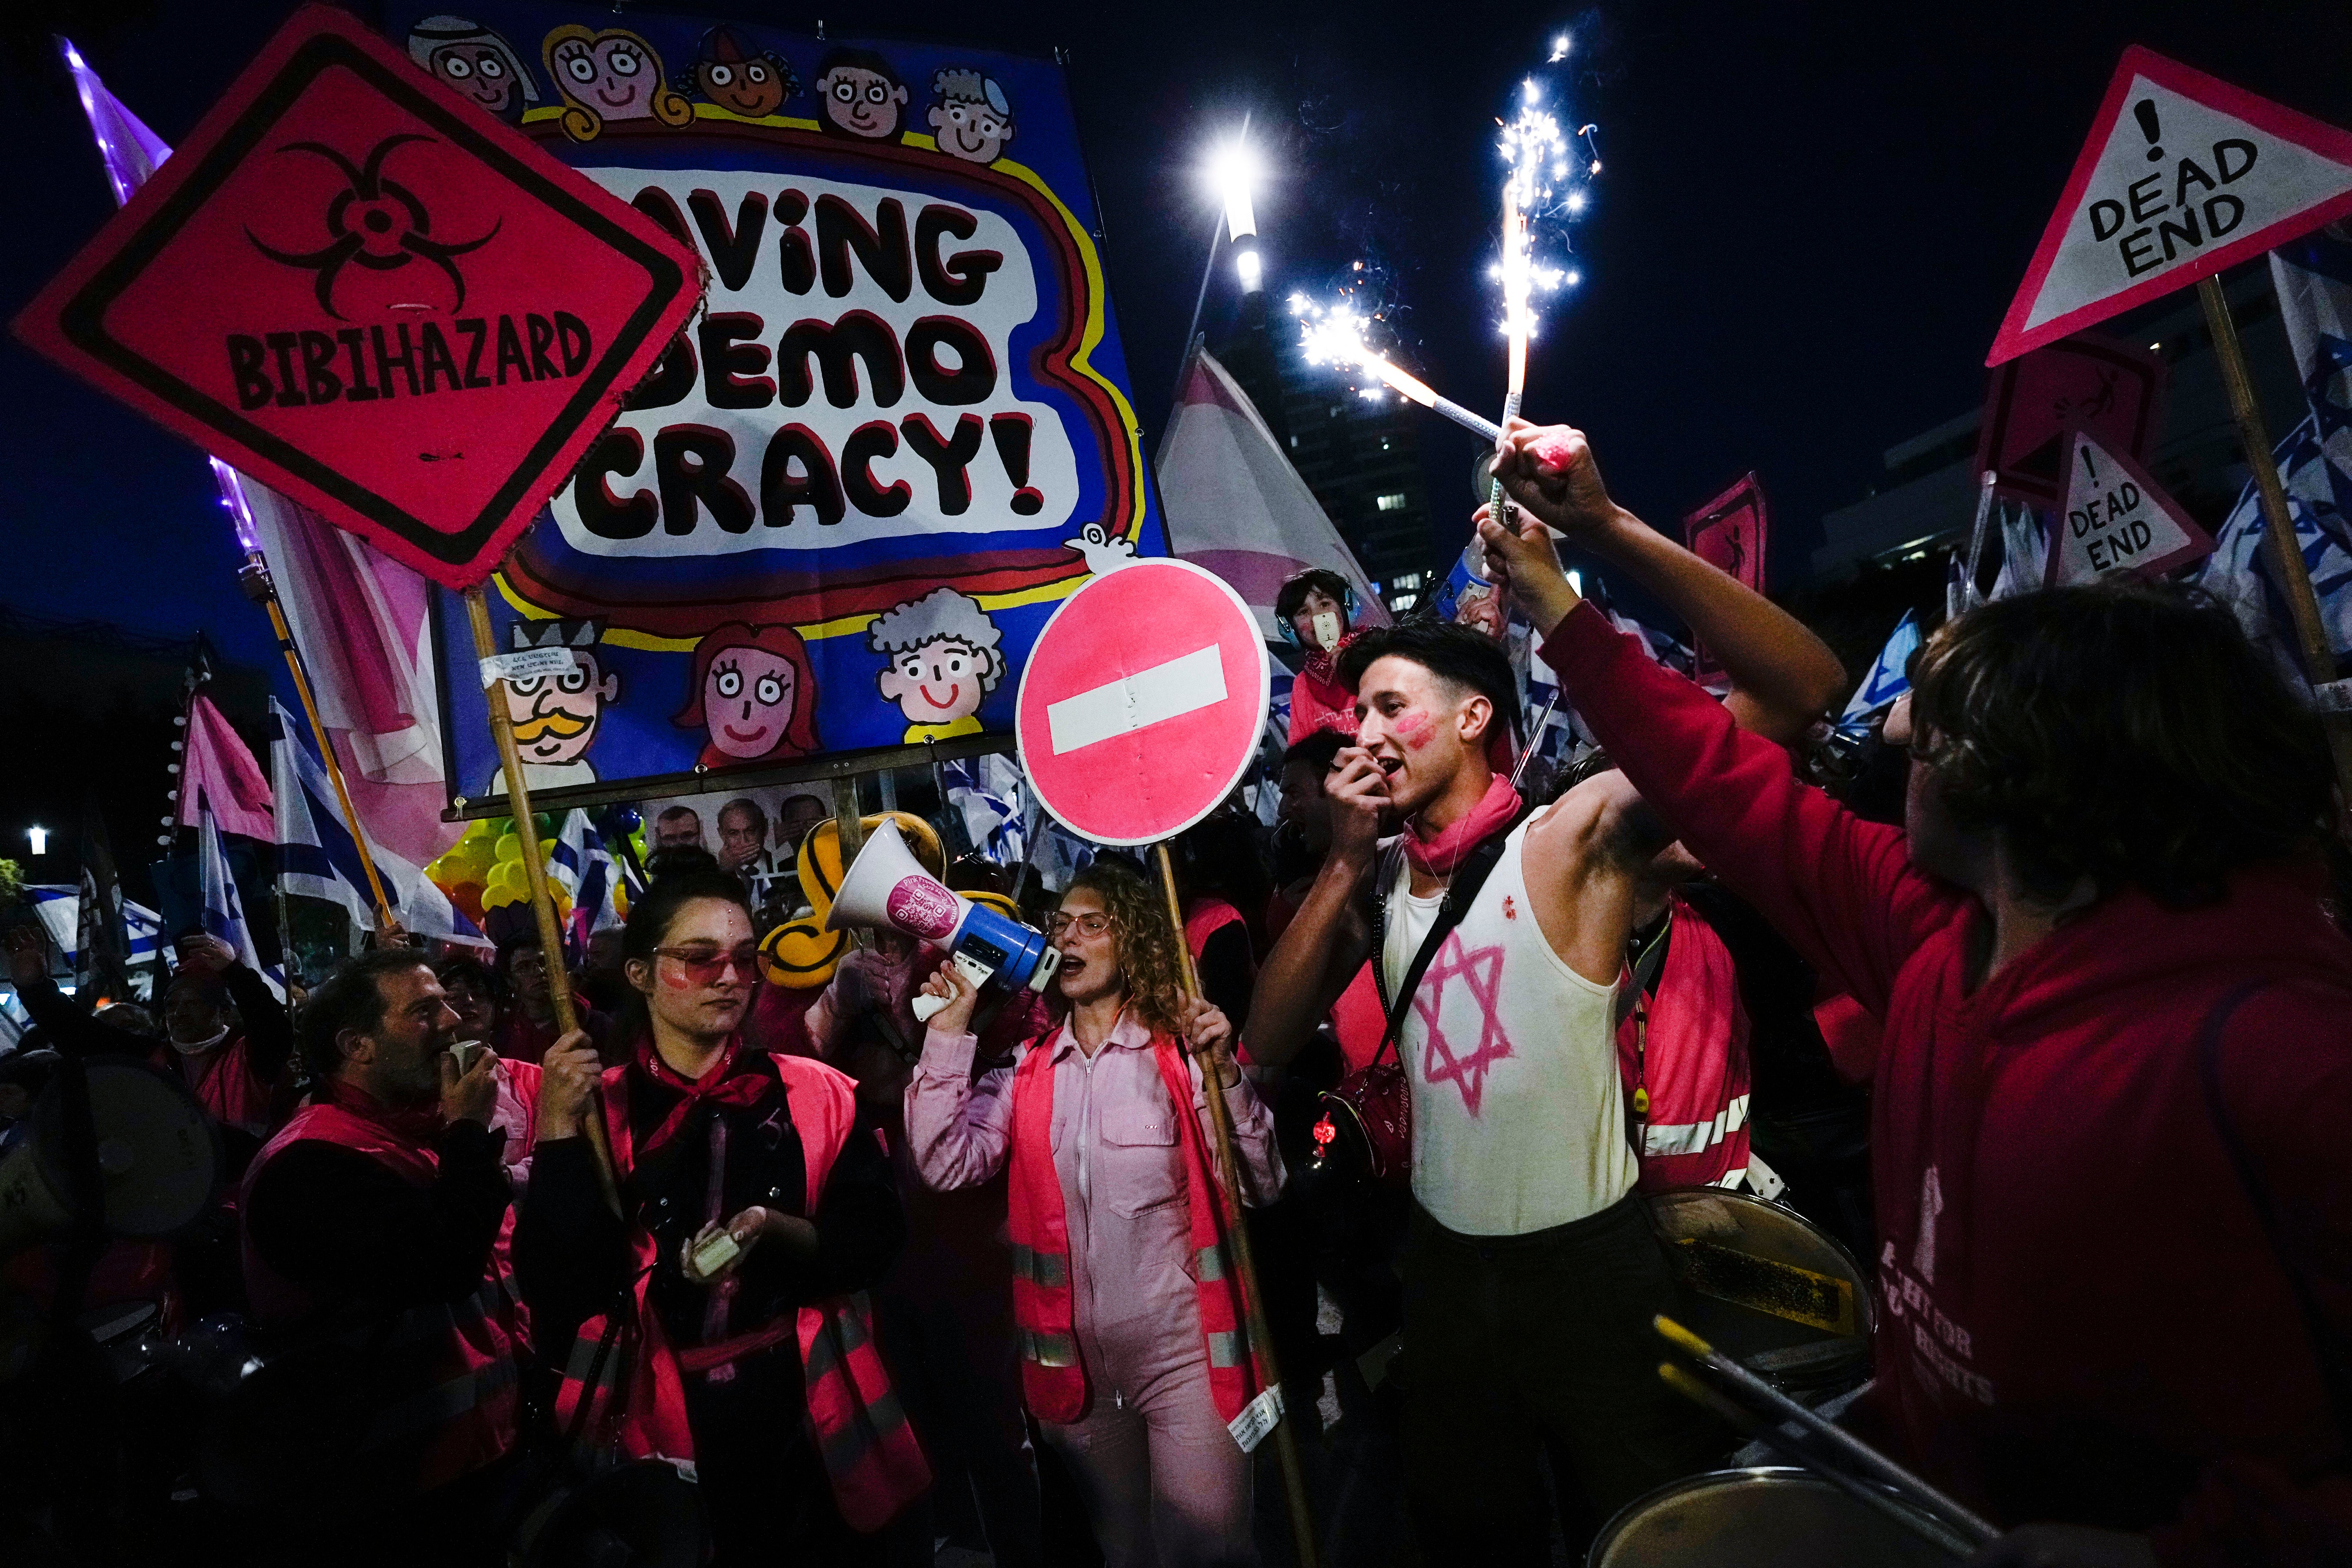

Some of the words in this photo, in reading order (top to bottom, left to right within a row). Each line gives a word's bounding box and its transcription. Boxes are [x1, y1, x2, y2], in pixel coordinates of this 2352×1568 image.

[2134, 99, 2165, 162] !
[2089, 138, 2257, 242] DEAD
[2119, 194, 2244, 278] END
[226, 310, 592, 411] BIBIHAZARD
[573, 411, 1045, 540] CRACY!
[2080, 446, 2099, 488] !
[2069, 482, 2139, 539] DEAD
[2086, 520, 2151, 572] END
[903, 876, 918, 886] Pink
